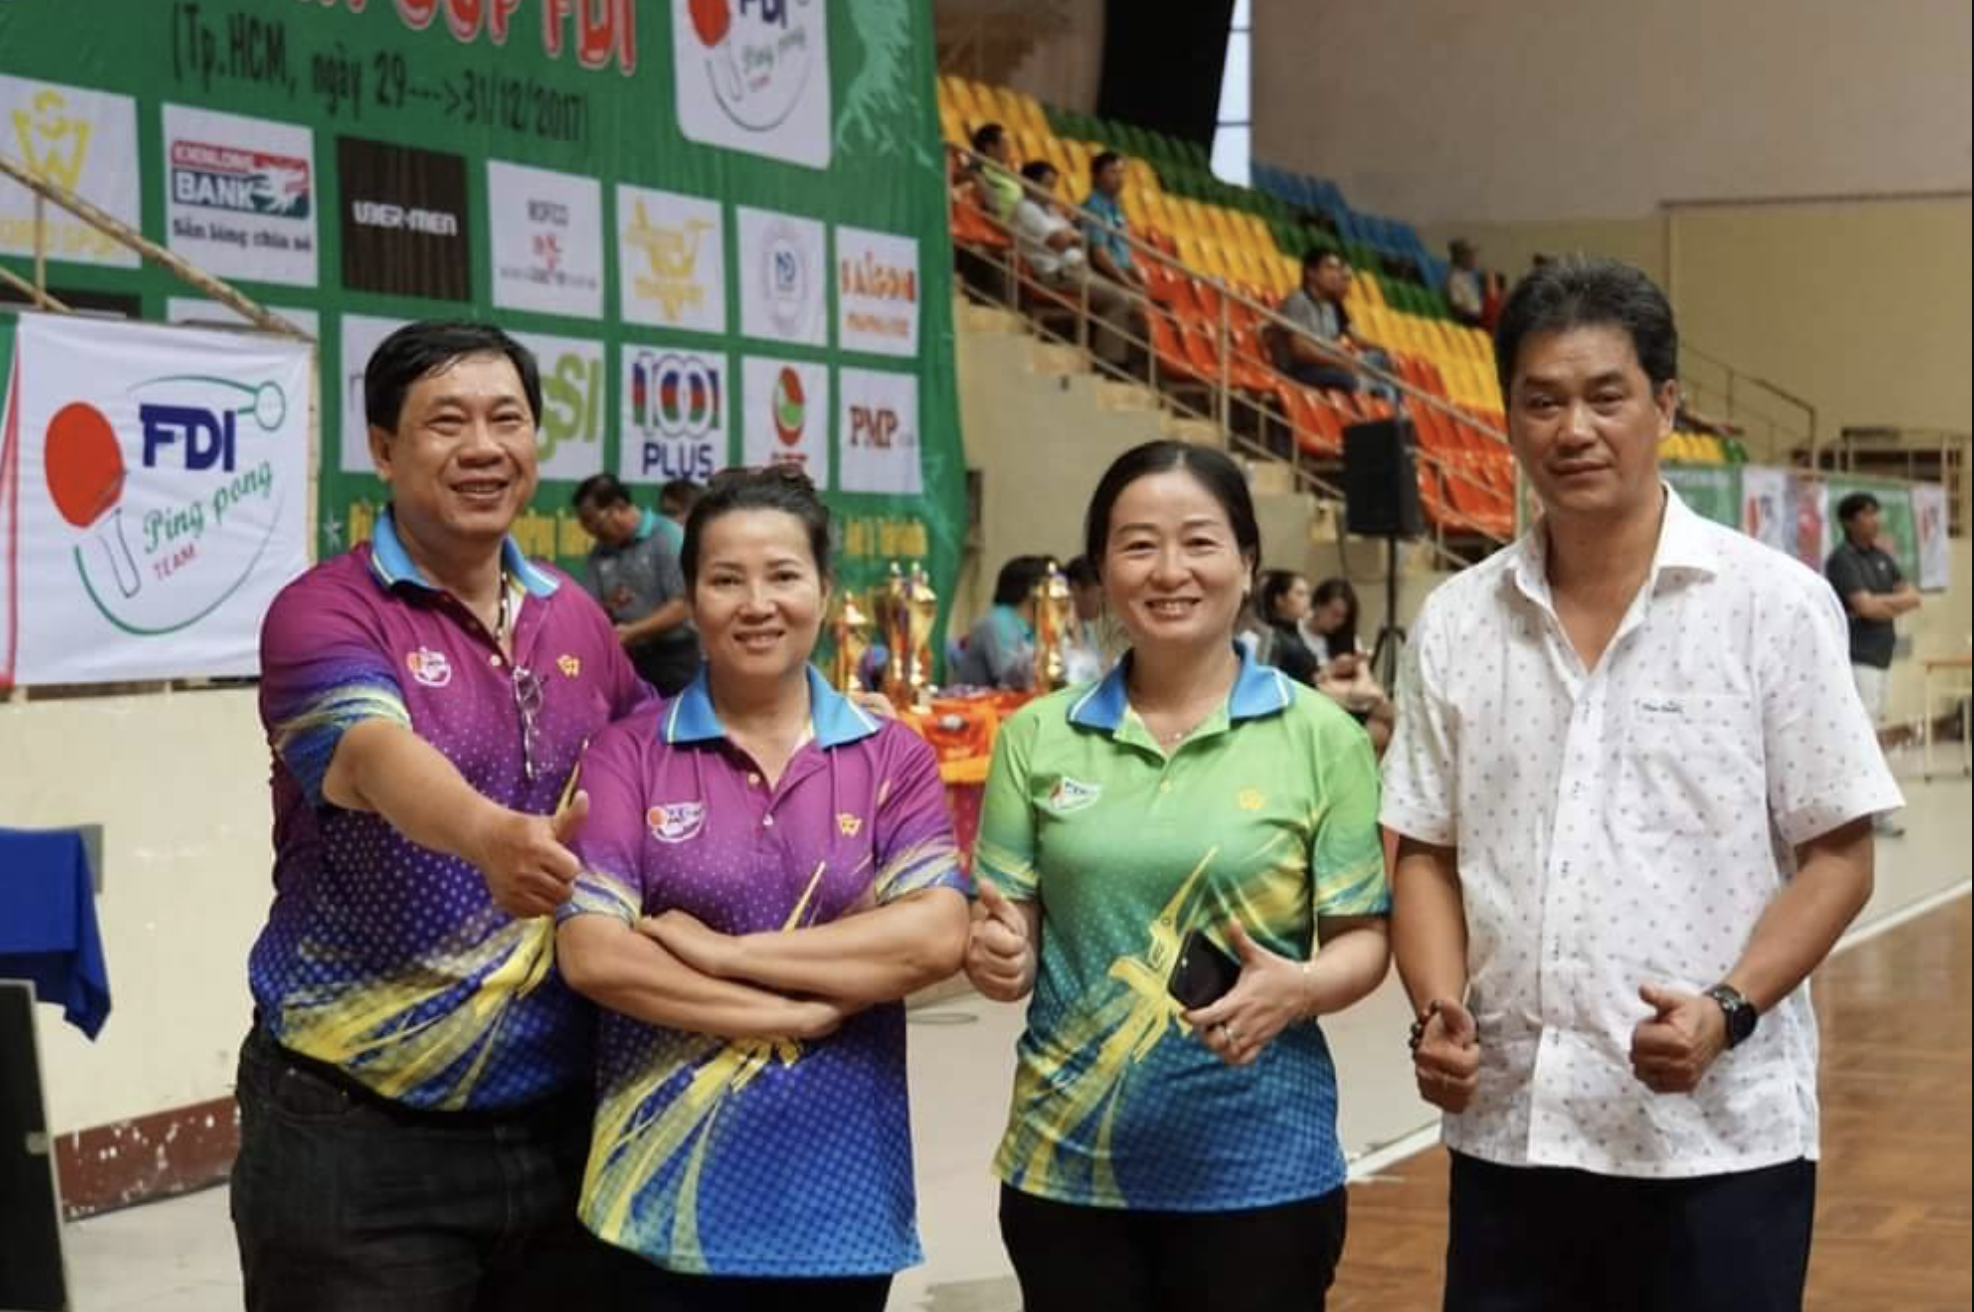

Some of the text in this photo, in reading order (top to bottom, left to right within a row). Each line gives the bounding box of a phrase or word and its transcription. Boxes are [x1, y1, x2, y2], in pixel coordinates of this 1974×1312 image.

[541, 0, 637, 77] FDI
[175, 171, 255, 209] BANK
[139, 403, 237, 473] FDI
[849, 405, 899, 450] PMP
[642, 442, 714, 481] PLUS
[142, 460, 273, 554] Ping pong
[153, 541, 196, 580] TEAM
